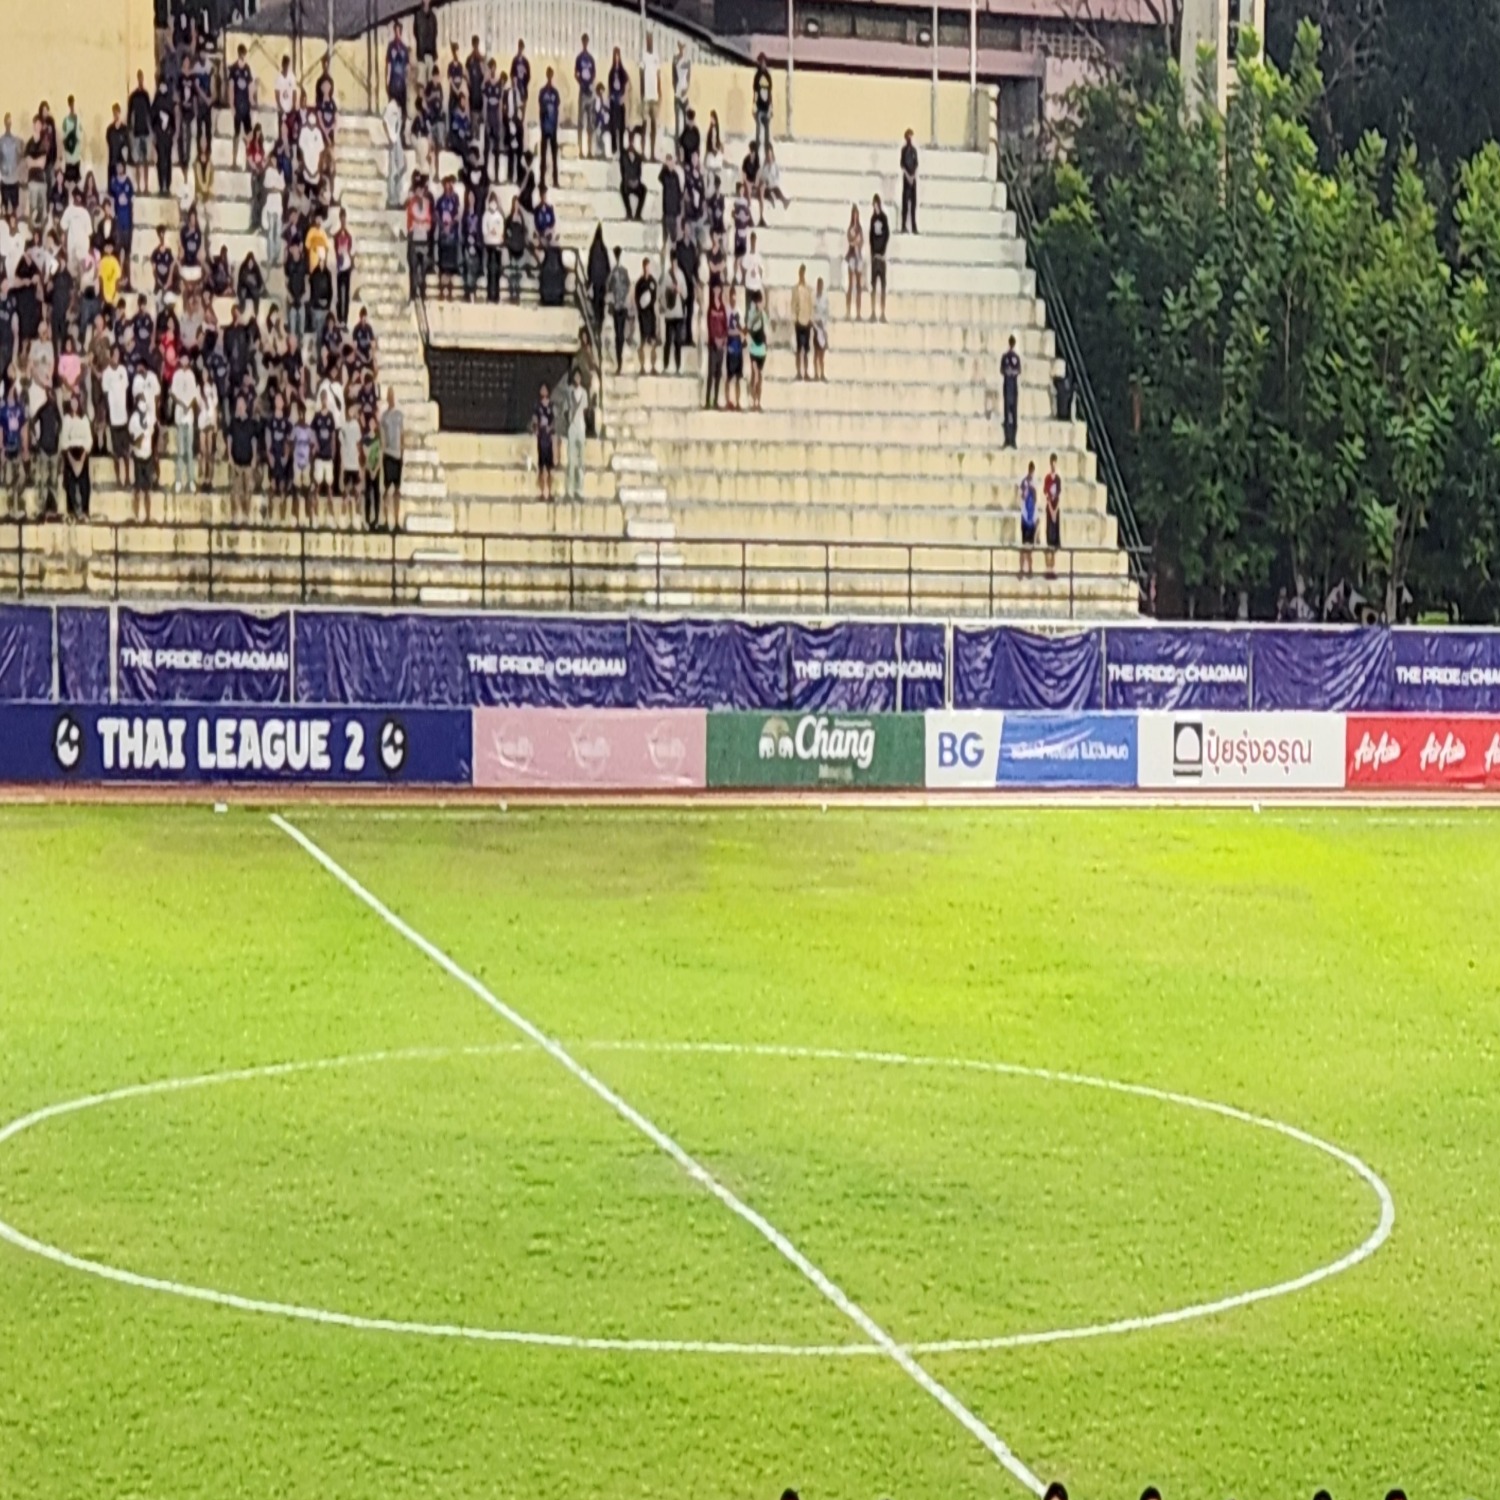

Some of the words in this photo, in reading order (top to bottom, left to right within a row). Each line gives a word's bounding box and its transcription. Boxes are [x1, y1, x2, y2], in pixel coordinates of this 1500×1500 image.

[120, 648, 154, 668] THE
[155, 649, 203, 669] PRIDE
[467, 653, 498, 674] THE
[499, 654, 546, 675] PRIDE
[793, 660, 821, 680] THE
[823, 660, 864, 679] PRIDE
[1107, 663, 1134, 683] THE
[1135, 663, 1176, 683] PRIDE
[1396, 666, 1421, 685] THE
[1422, 666, 1461, 686] PRIDE
[97, 717, 187, 769] THAI
[197, 718, 332, 770] LEAGUE
[343, 720, 365, 771] 2
[795, 715, 876, 769] Chang
[938, 731, 984, 767] BG
